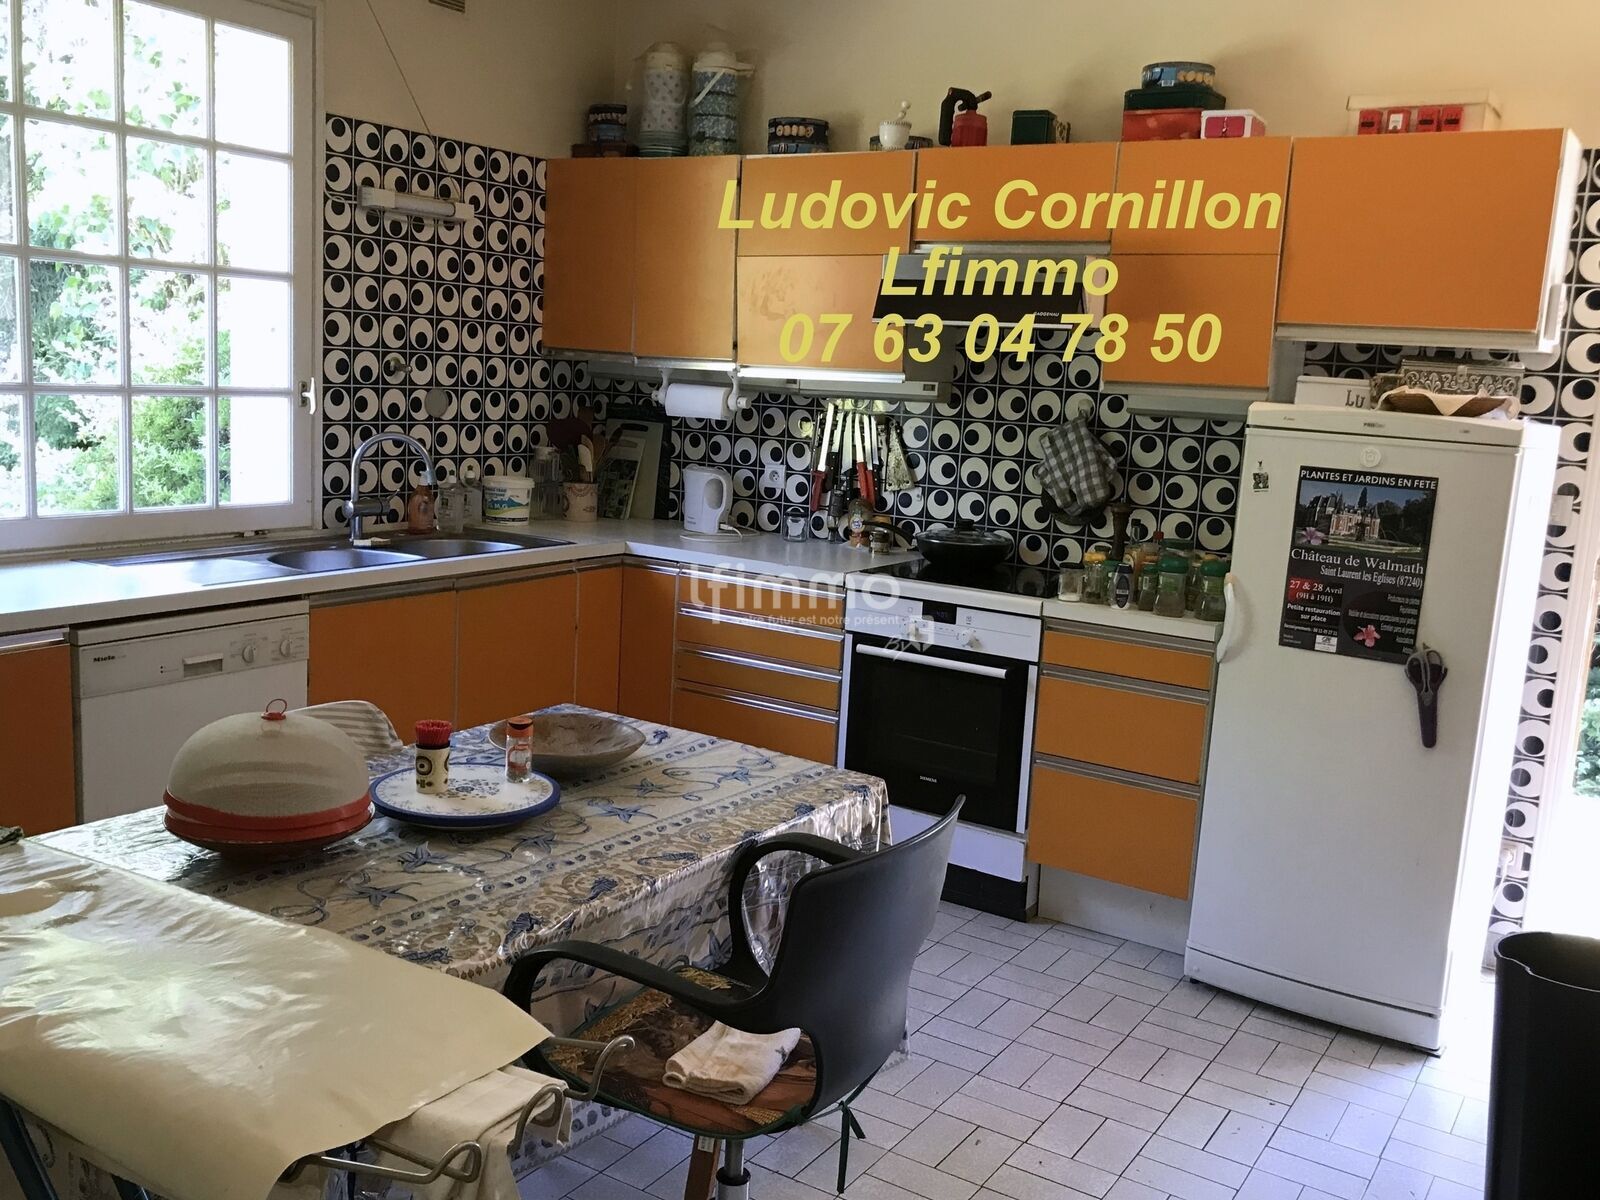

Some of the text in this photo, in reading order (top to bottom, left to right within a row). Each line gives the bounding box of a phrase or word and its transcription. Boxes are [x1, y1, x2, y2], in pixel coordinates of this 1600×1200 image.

[1300, 469, 1437, 490] PLANTES ET JARDINS EN FETE
[1291, 548, 1424, 575] Château de Walmath
[1320, 564, 1337, 577] Saint
[1337, 567, 1362, 580] Laurent
[1372, 571, 1396, 586] Eglises
[1396, 575, 1423, 590] (87240)
[1289, 579, 1343, 595] 27 & 28 Avril
[1287, 602, 1304, 612] Petite
[1304, 606, 1341, 617] restauration
[1310, 615, 1327, 623] place
